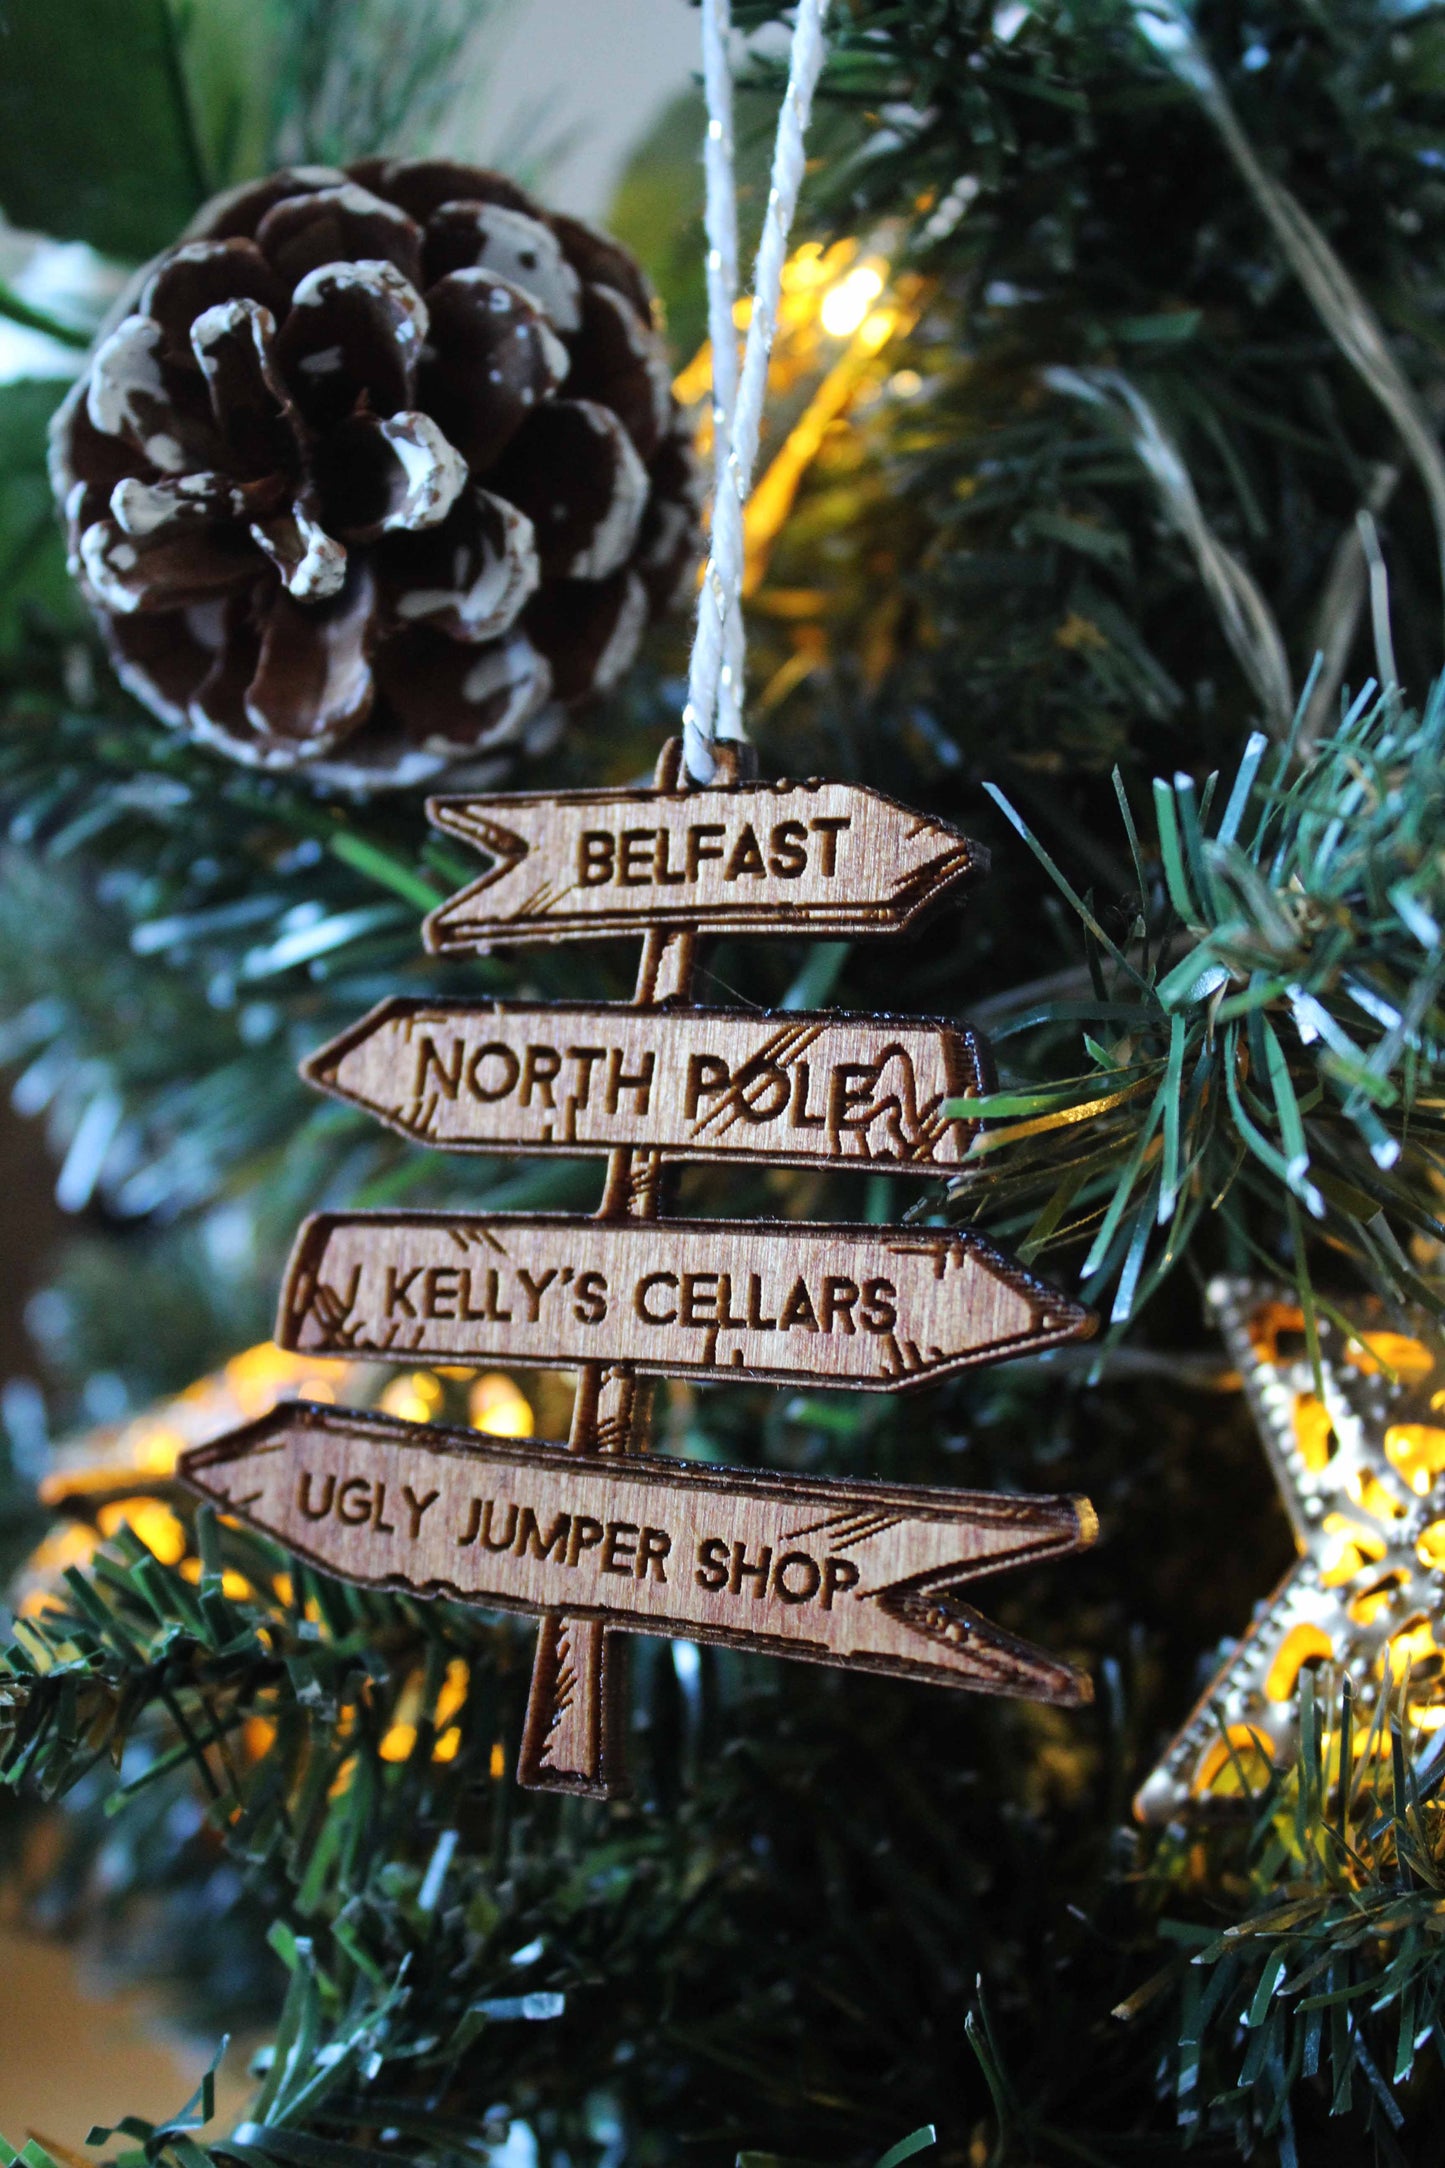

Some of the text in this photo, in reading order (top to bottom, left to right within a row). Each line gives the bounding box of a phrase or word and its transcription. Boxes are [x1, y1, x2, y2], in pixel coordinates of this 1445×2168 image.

[577, 816, 851, 888] BELFAST
[413, 1035, 879, 1131] NORTH POLE
[385, 1266, 898, 1335] KELLY'S CELLARS
[300, 1471, 860, 1611] UGLY JUMPER SHOP
